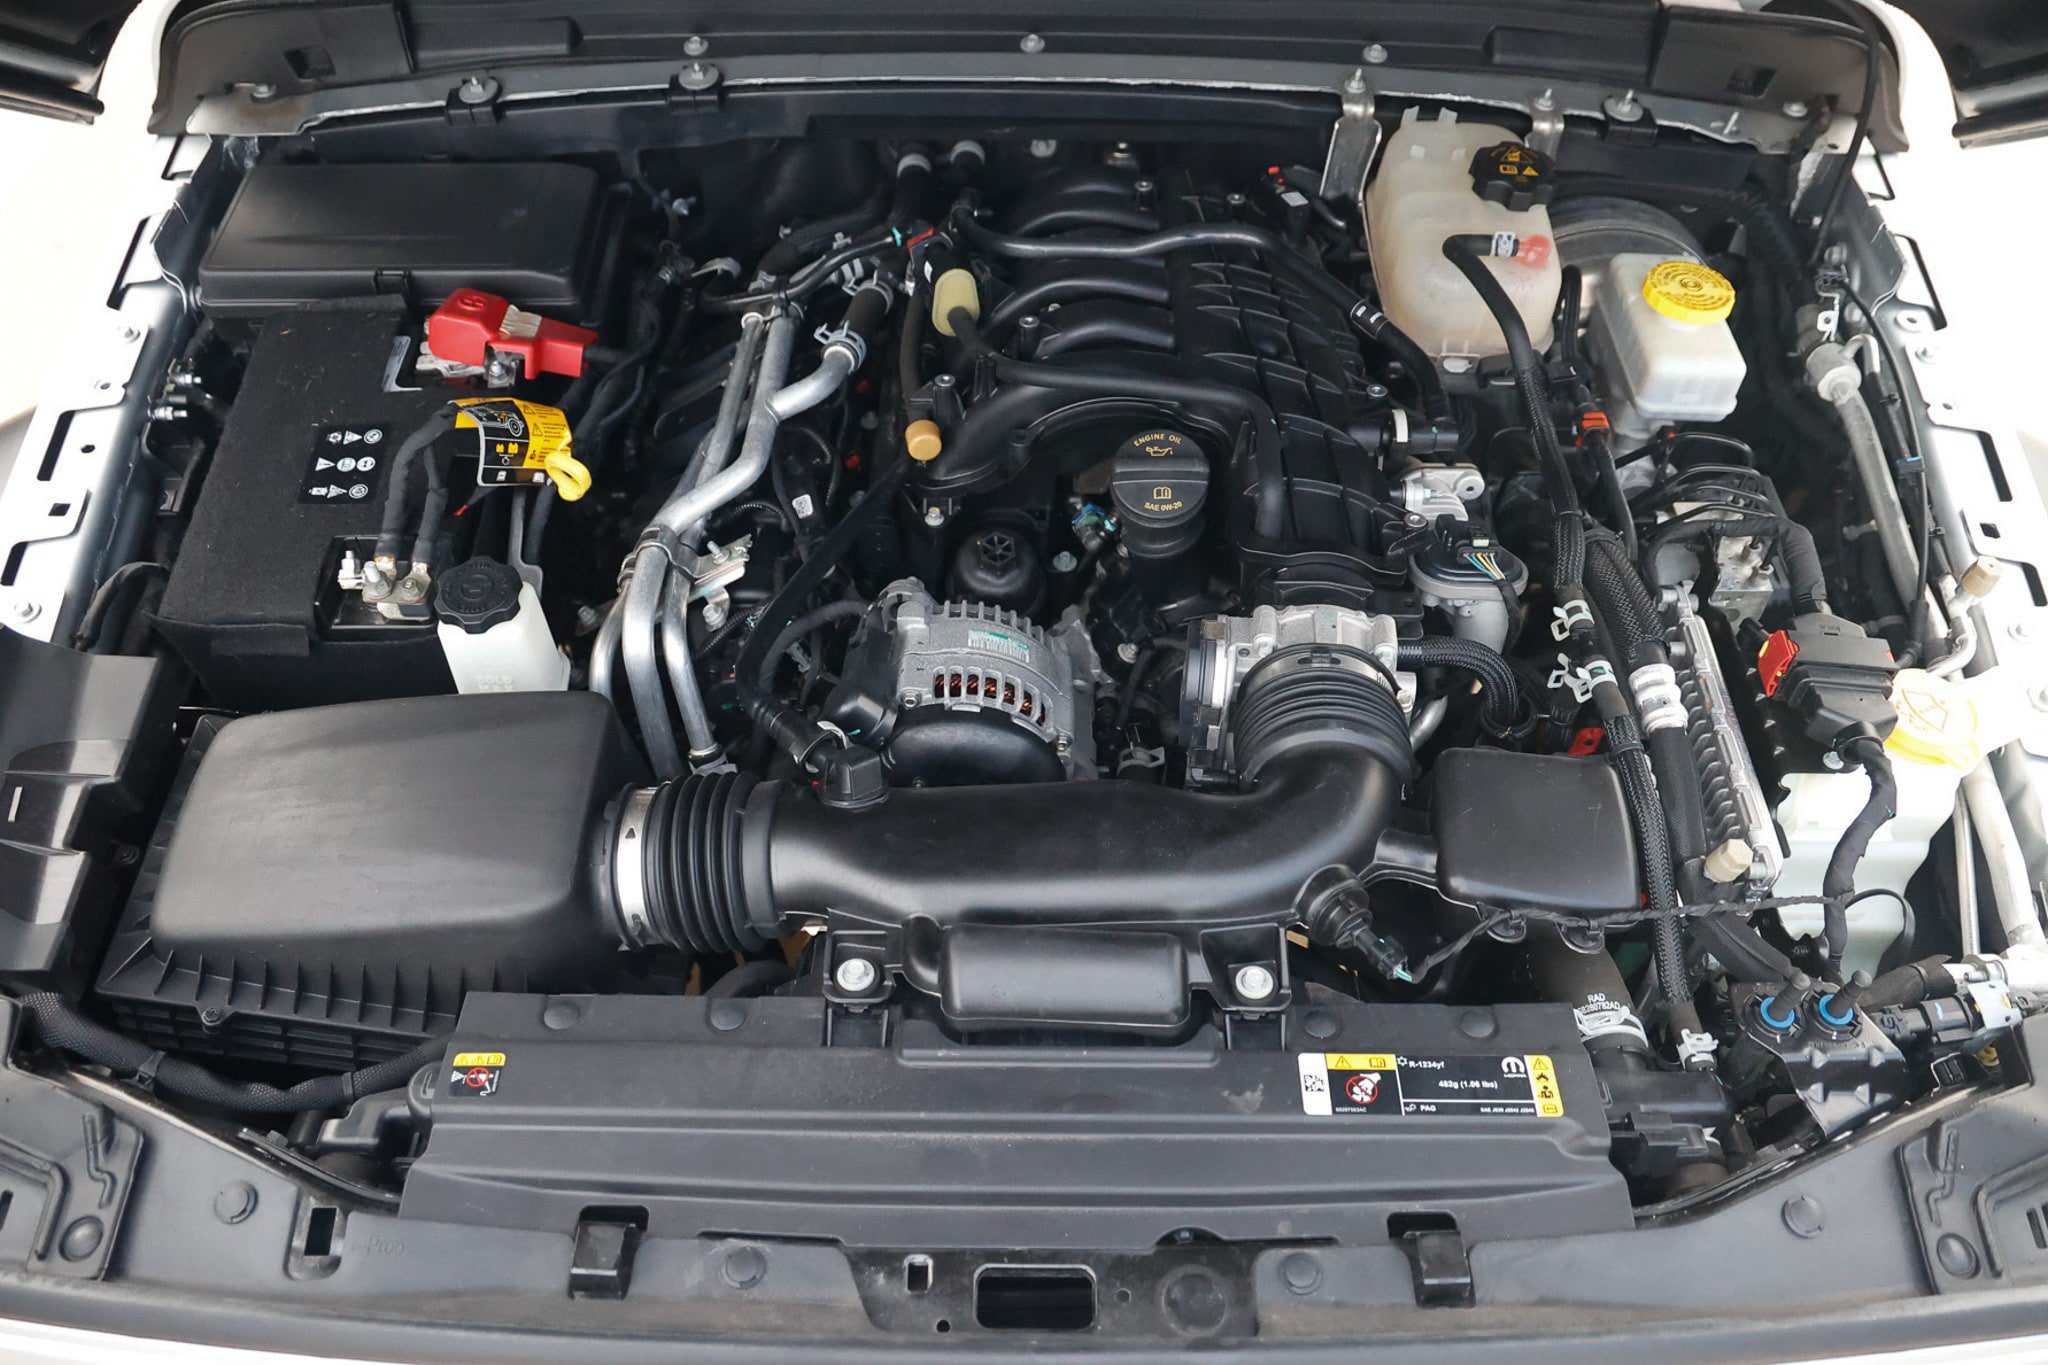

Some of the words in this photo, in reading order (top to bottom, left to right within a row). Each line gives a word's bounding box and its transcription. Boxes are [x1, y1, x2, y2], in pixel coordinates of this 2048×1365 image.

[1133, 433, 1165, 447] ENGINE
[1168, 434, 1182, 445] OIL
[1144, 502, 1160, 512] SAE
[1160, 501, 1183, 512] 0W-20
[1587, 992, 1606, 1003] RAD
[1408, 1060, 1445, 1070] R-1234yf
[1420, 1104, 1437, 1112] PAG
